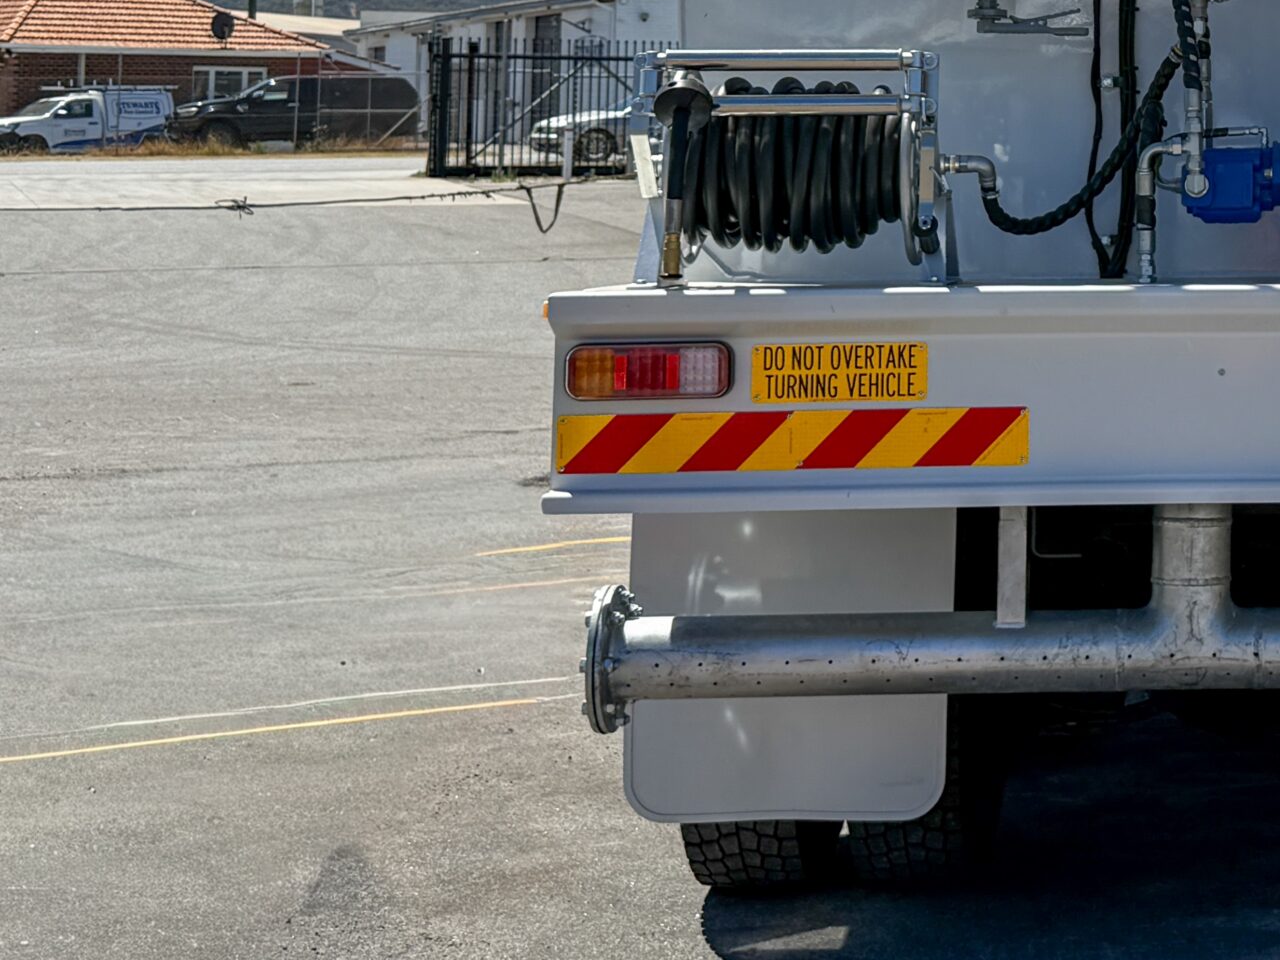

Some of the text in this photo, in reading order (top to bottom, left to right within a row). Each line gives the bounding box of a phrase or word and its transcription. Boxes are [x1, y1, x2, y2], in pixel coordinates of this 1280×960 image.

[763, 344, 917, 371] DO NOT OVERTAKE
[765, 372, 917, 399] TURNING VEHICLE
